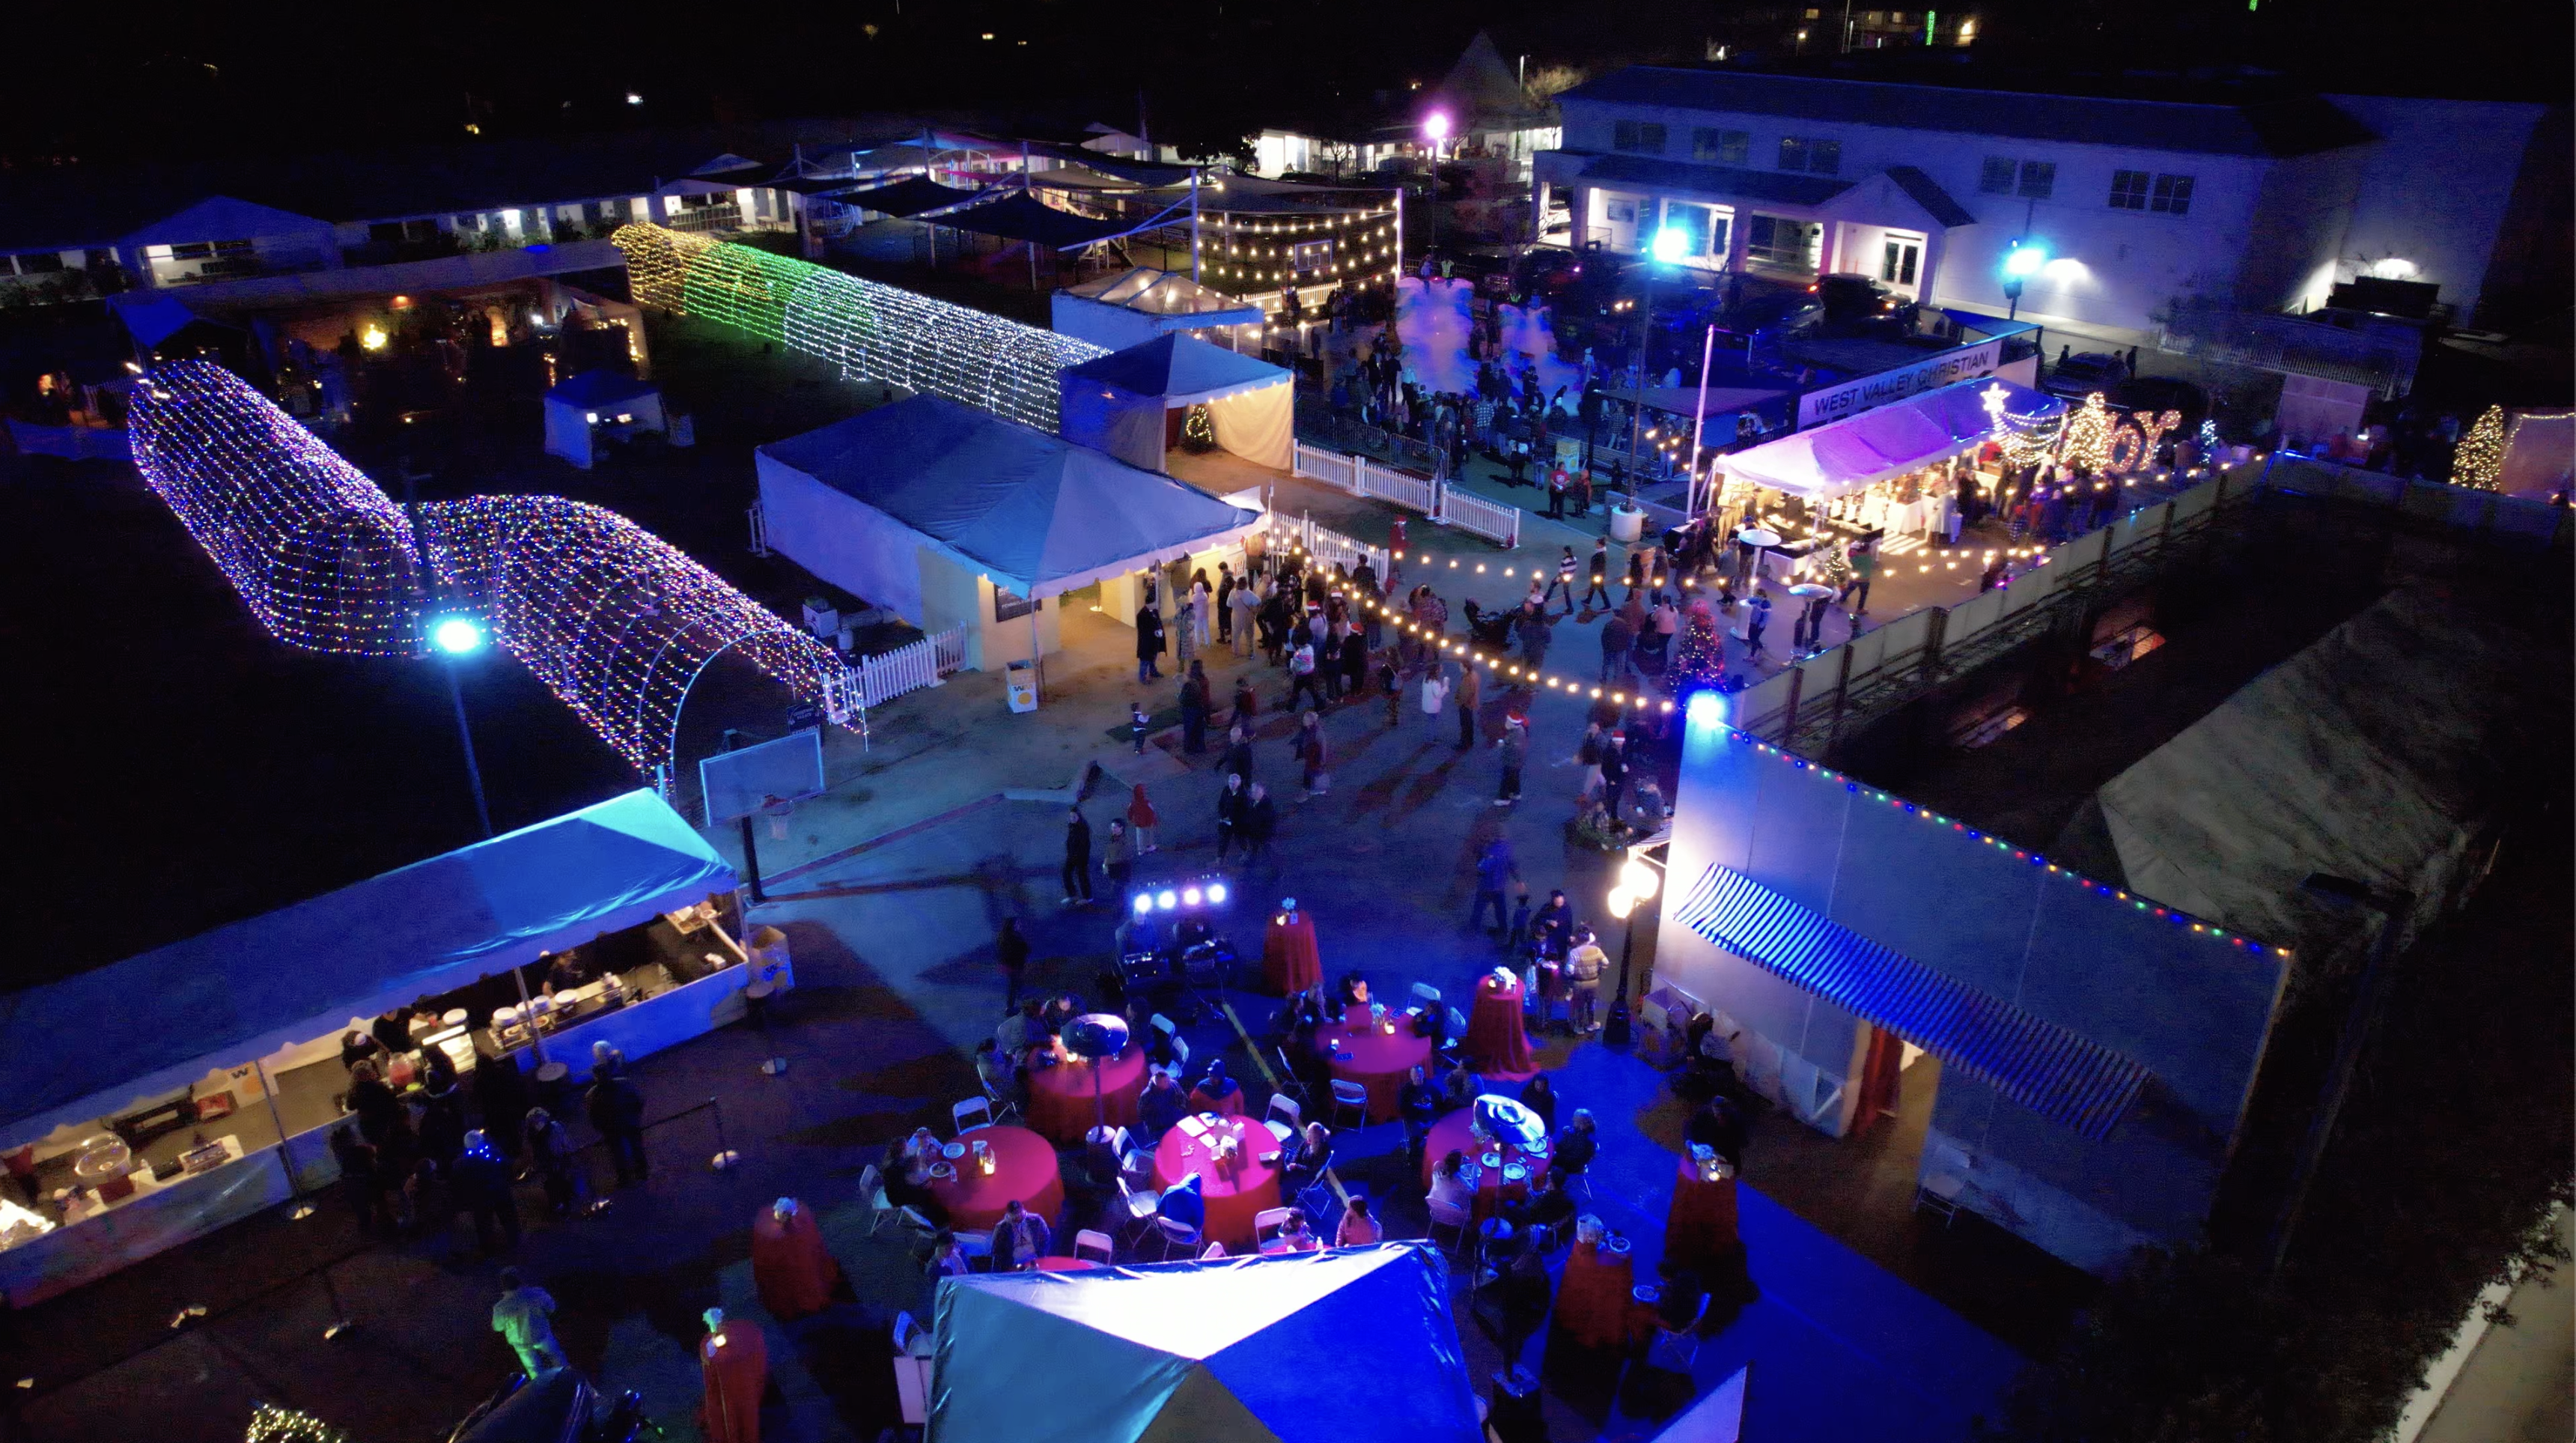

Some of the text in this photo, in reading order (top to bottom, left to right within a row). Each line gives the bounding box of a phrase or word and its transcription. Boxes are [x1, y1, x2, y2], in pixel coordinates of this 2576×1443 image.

[1815, 388, 1860, 416] WEST
[1862, 373, 1914, 401] VALLEY
[1917, 350, 1988, 385] CHRISTIAN
